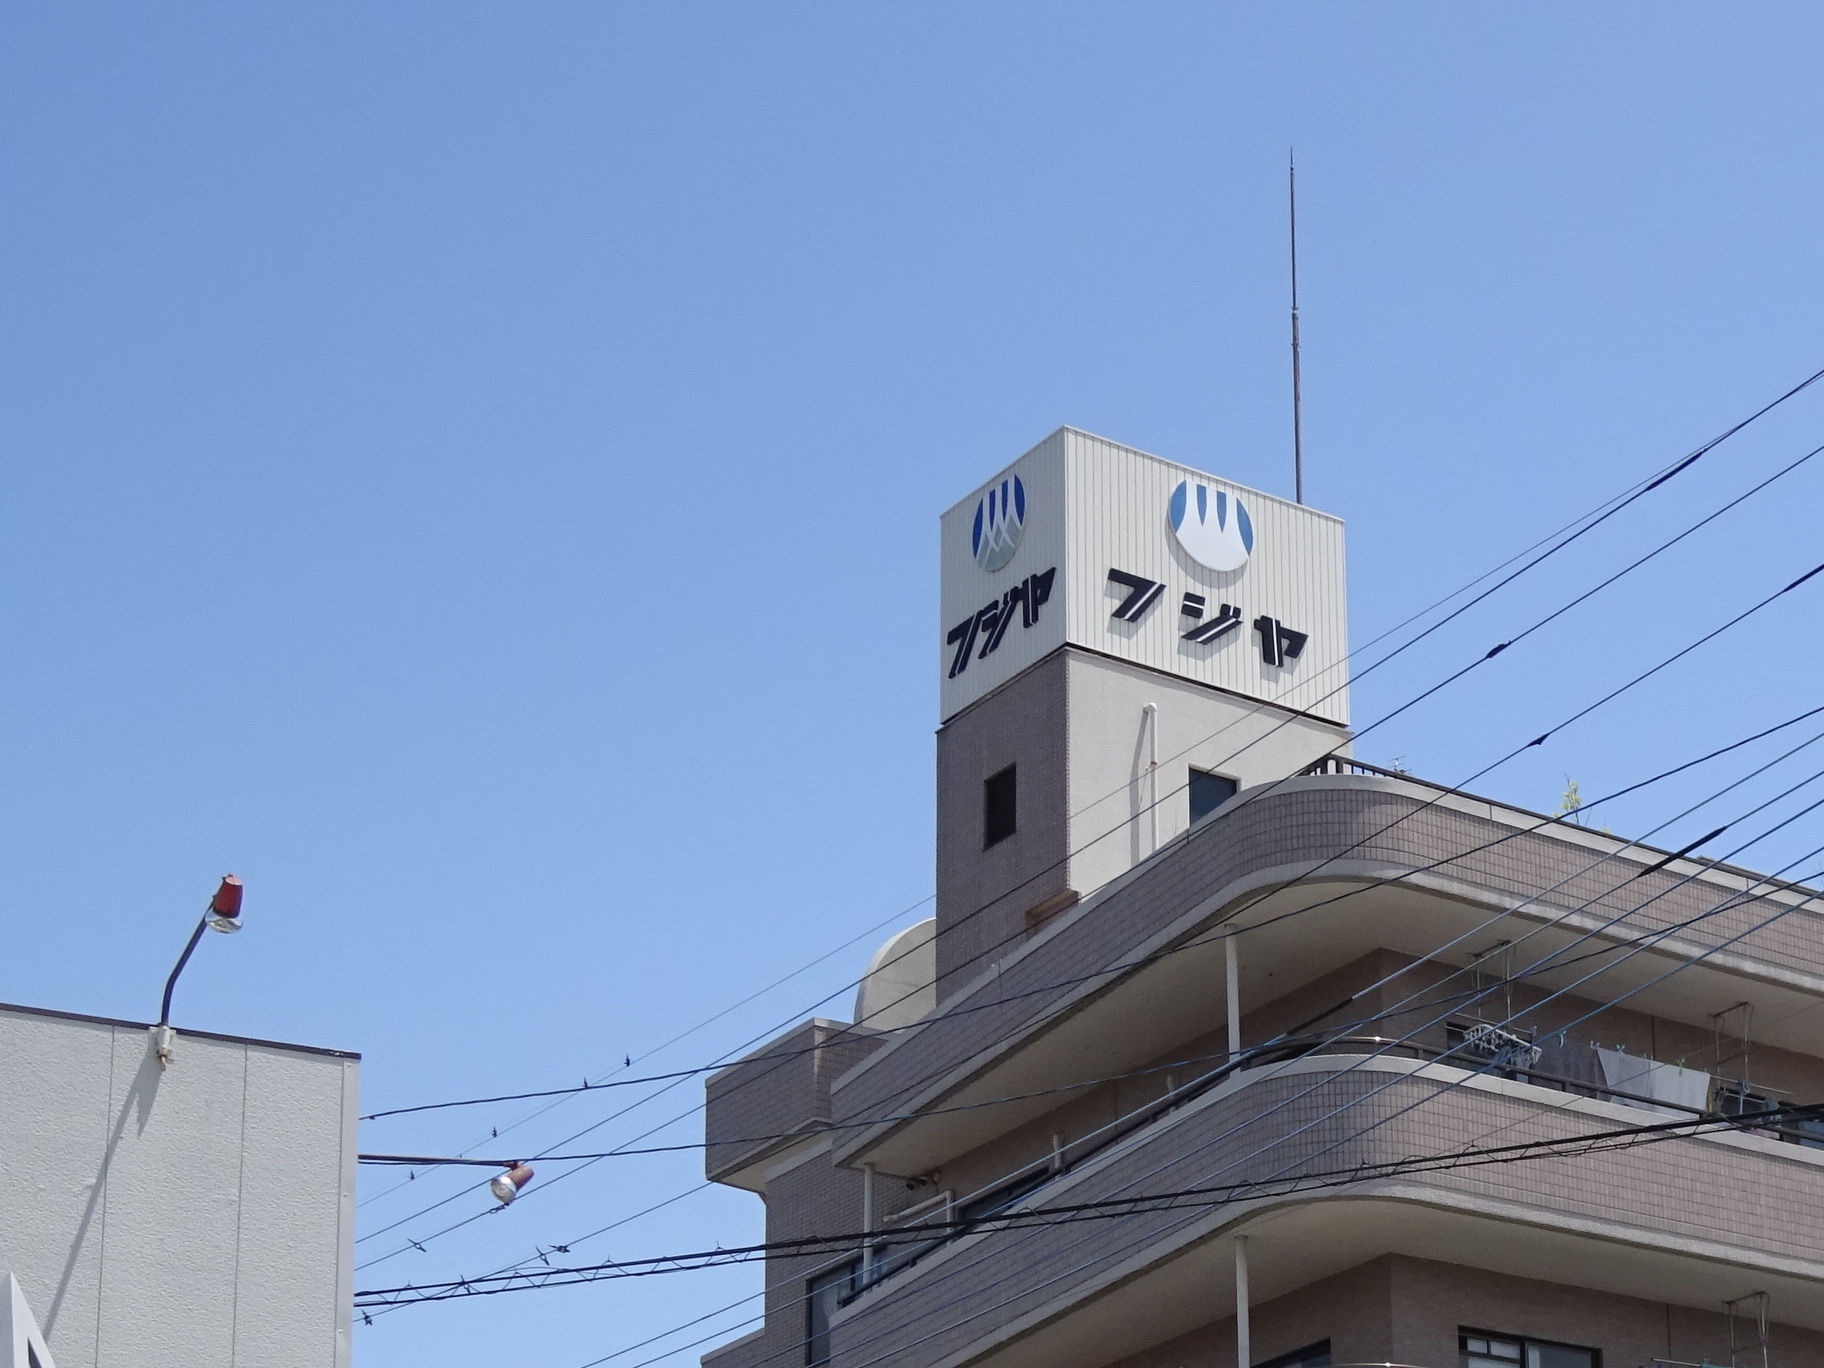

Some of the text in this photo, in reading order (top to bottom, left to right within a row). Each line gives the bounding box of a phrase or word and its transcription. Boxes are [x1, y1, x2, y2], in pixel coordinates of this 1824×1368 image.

[947, 567, 1056, 679] フジヤ
[1108, 568, 1308, 667] フジヤ
